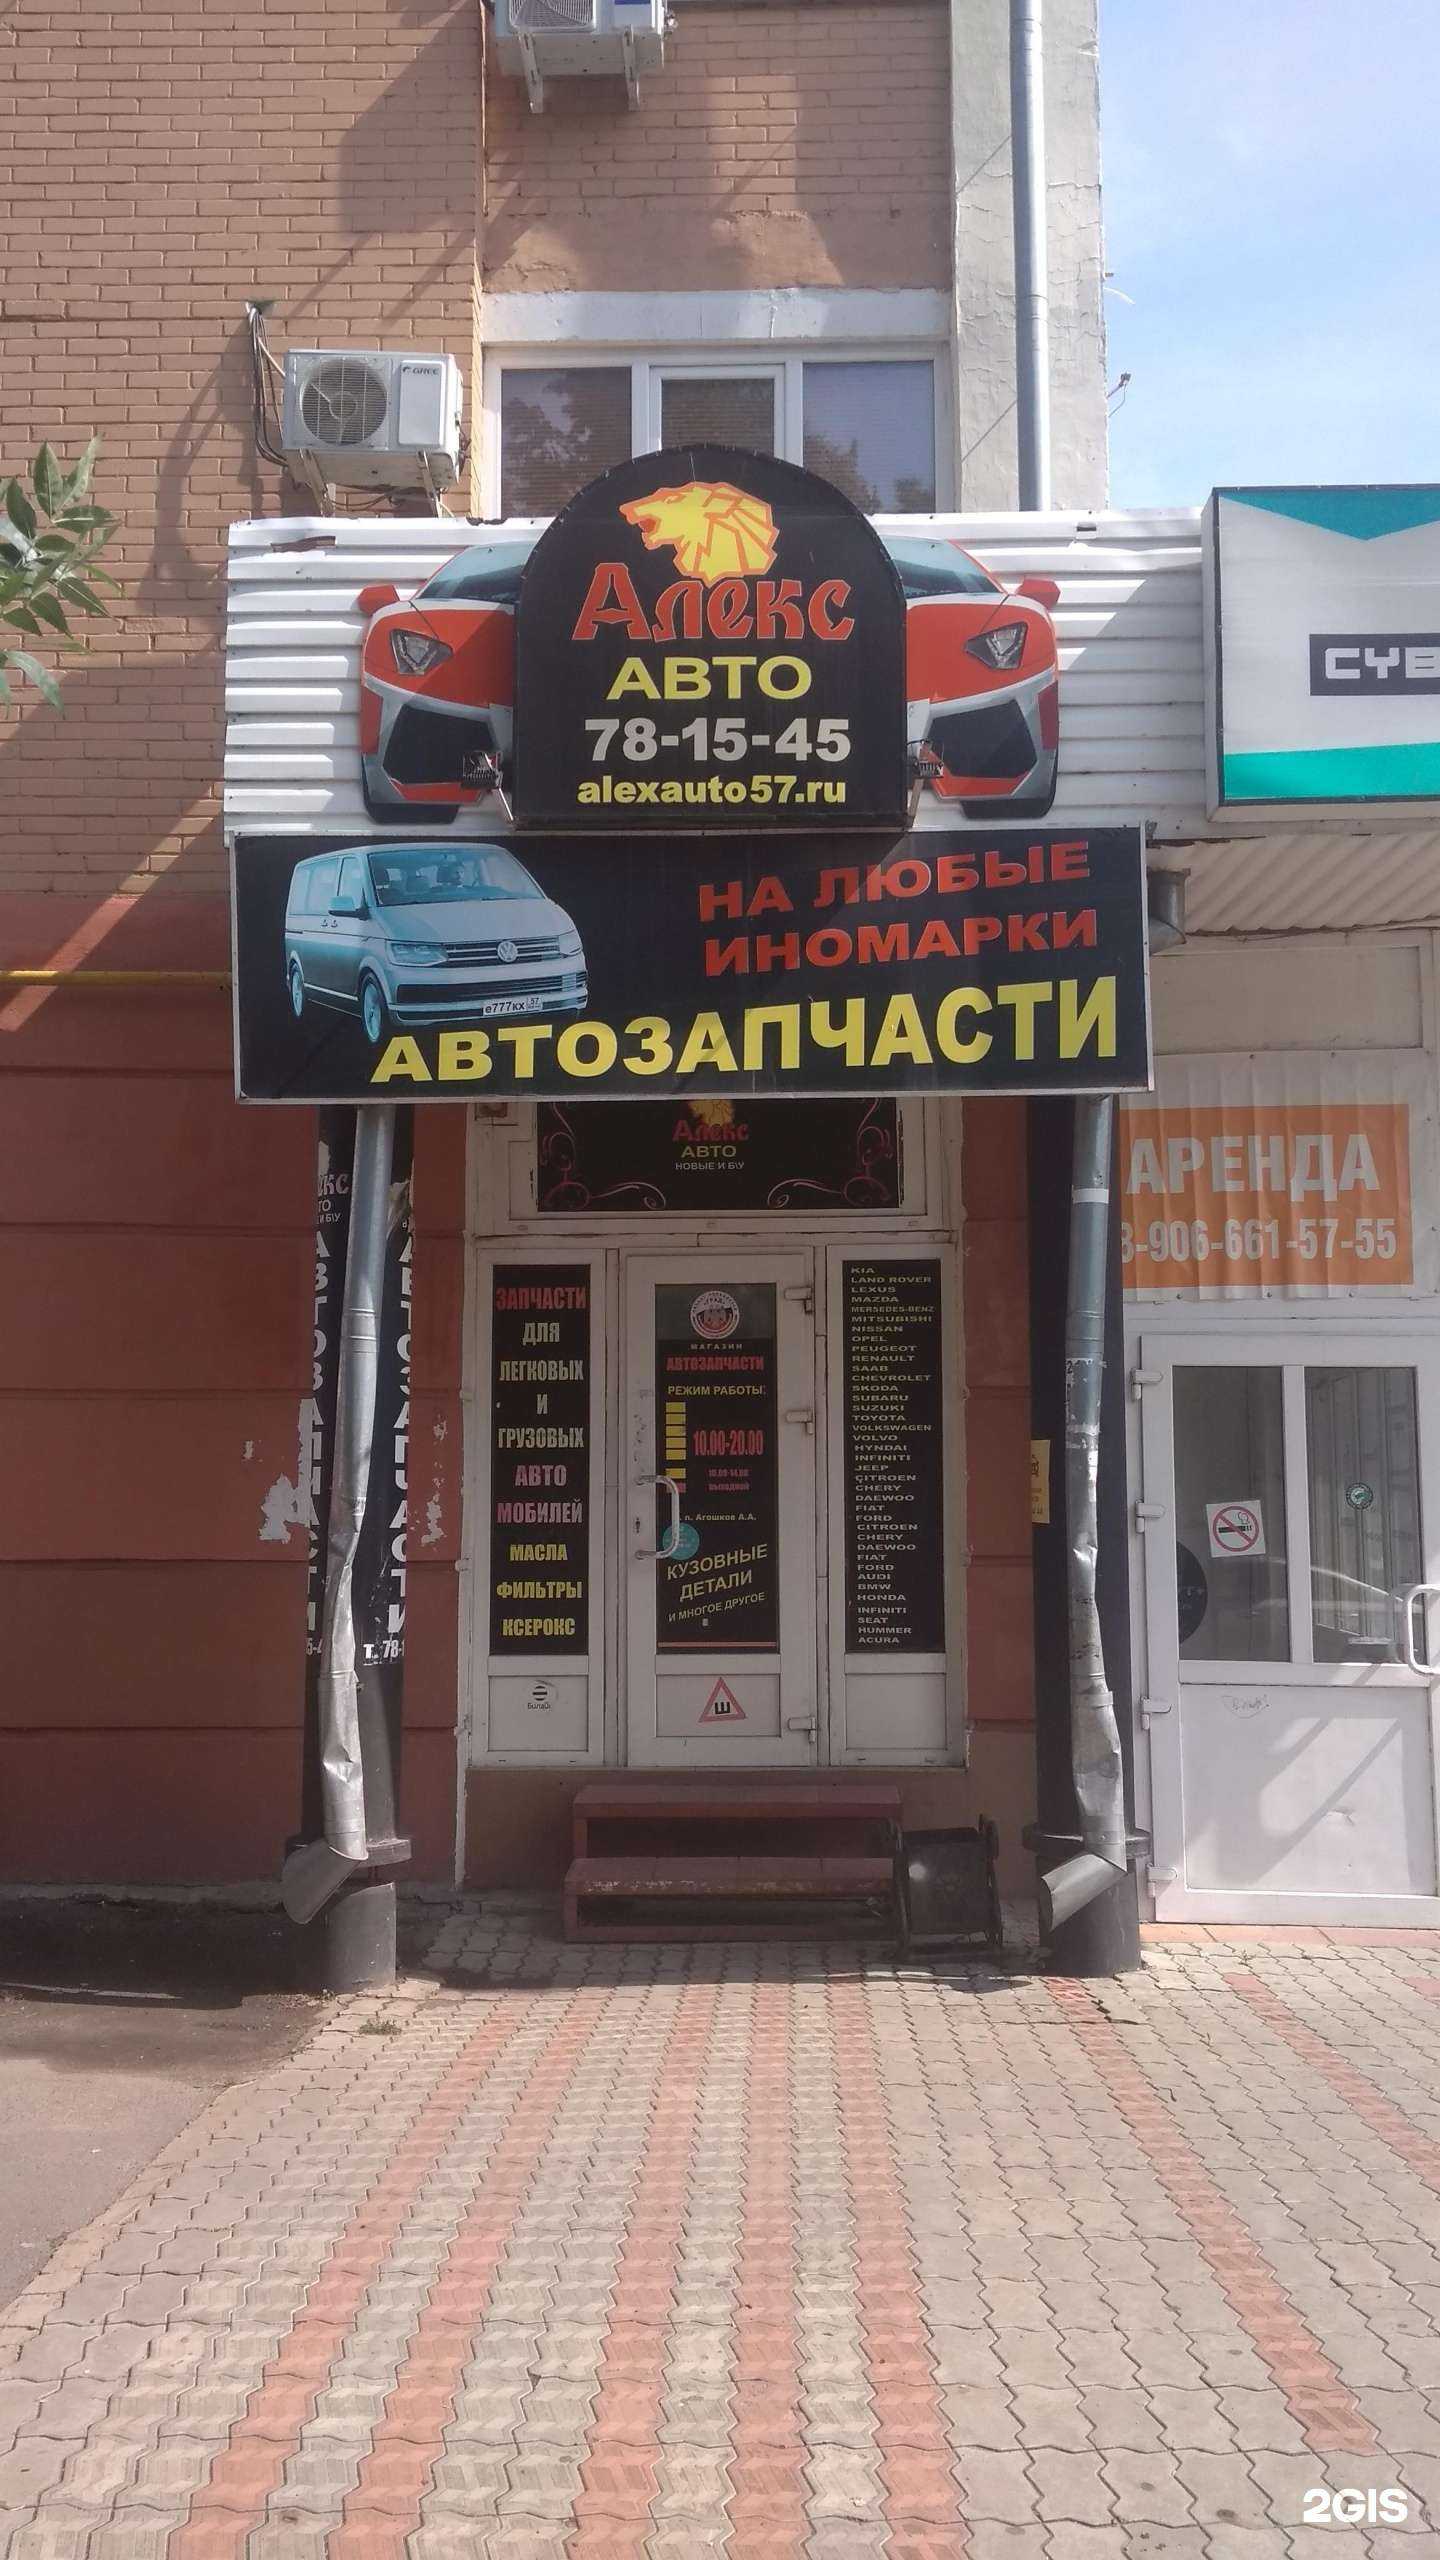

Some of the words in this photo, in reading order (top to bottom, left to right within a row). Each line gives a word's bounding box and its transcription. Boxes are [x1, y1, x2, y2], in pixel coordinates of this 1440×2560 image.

[571, 562, 856, 643] Алекс
[605, 655, 812, 700] АВТО
[584, 717, 852, 762] 78-15-45
[577, 774, 847, 804] alexauto57.ru
[700, 875, 794, 923] НА
[813, 840, 1091, 908] ЛЮБЫЕ
[705, 908, 1097, 977] ИНОМАРКИ
[370, 976, 1117, 1083] АВТОЗАПЧАСТИ
[672, 1119, 749, 1142] Алекс
[681, 1145, 737, 1158] АВТО
[675, 1162, 715, 1170] НОВЫЕ
[1125, 1133, 1381, 1202] АРЕНДА
[495, 1287, 586, 1310] ЗАПЧАСТИ
[522, 1322, 560, 1345] ДЛЯ
[499, 1360, 584, 1381] ЛЕГКОВЫХ
[666, 1356, 764, 1371] АВТОЗАПЧАСТИ
[668, 1385, 711, 1395] РЕЖИМ
[536, 1394, 548, 1414] И
[498, 1427, 584, 1448] ГРУЗОВЫХ
[514, 1465, 567, 1486] АВТО
[496, 1499, 583, 1524] МОБИЛЕЙ
[855, 1514, 892, 1522] FORD
[509, 1544, 568, 1561] МАСЛА
[666, 1544, 768, 1580] КУЗОВНЫЕ
[496, 1581, 583, 1599] ФИЛЬТРЫ
[679, 1569, 753, 1602] ДЕТАЛИ
[668, 1611, 676, 1623] И
[678, 1602, 722, 1621] МНОГОЕ
[725, 1591, 766, 1611] ДРУГОЕ
[502, 1617, 576, 1637] КСЕРОКС
[714, 1701, 732, 1715] Ш
